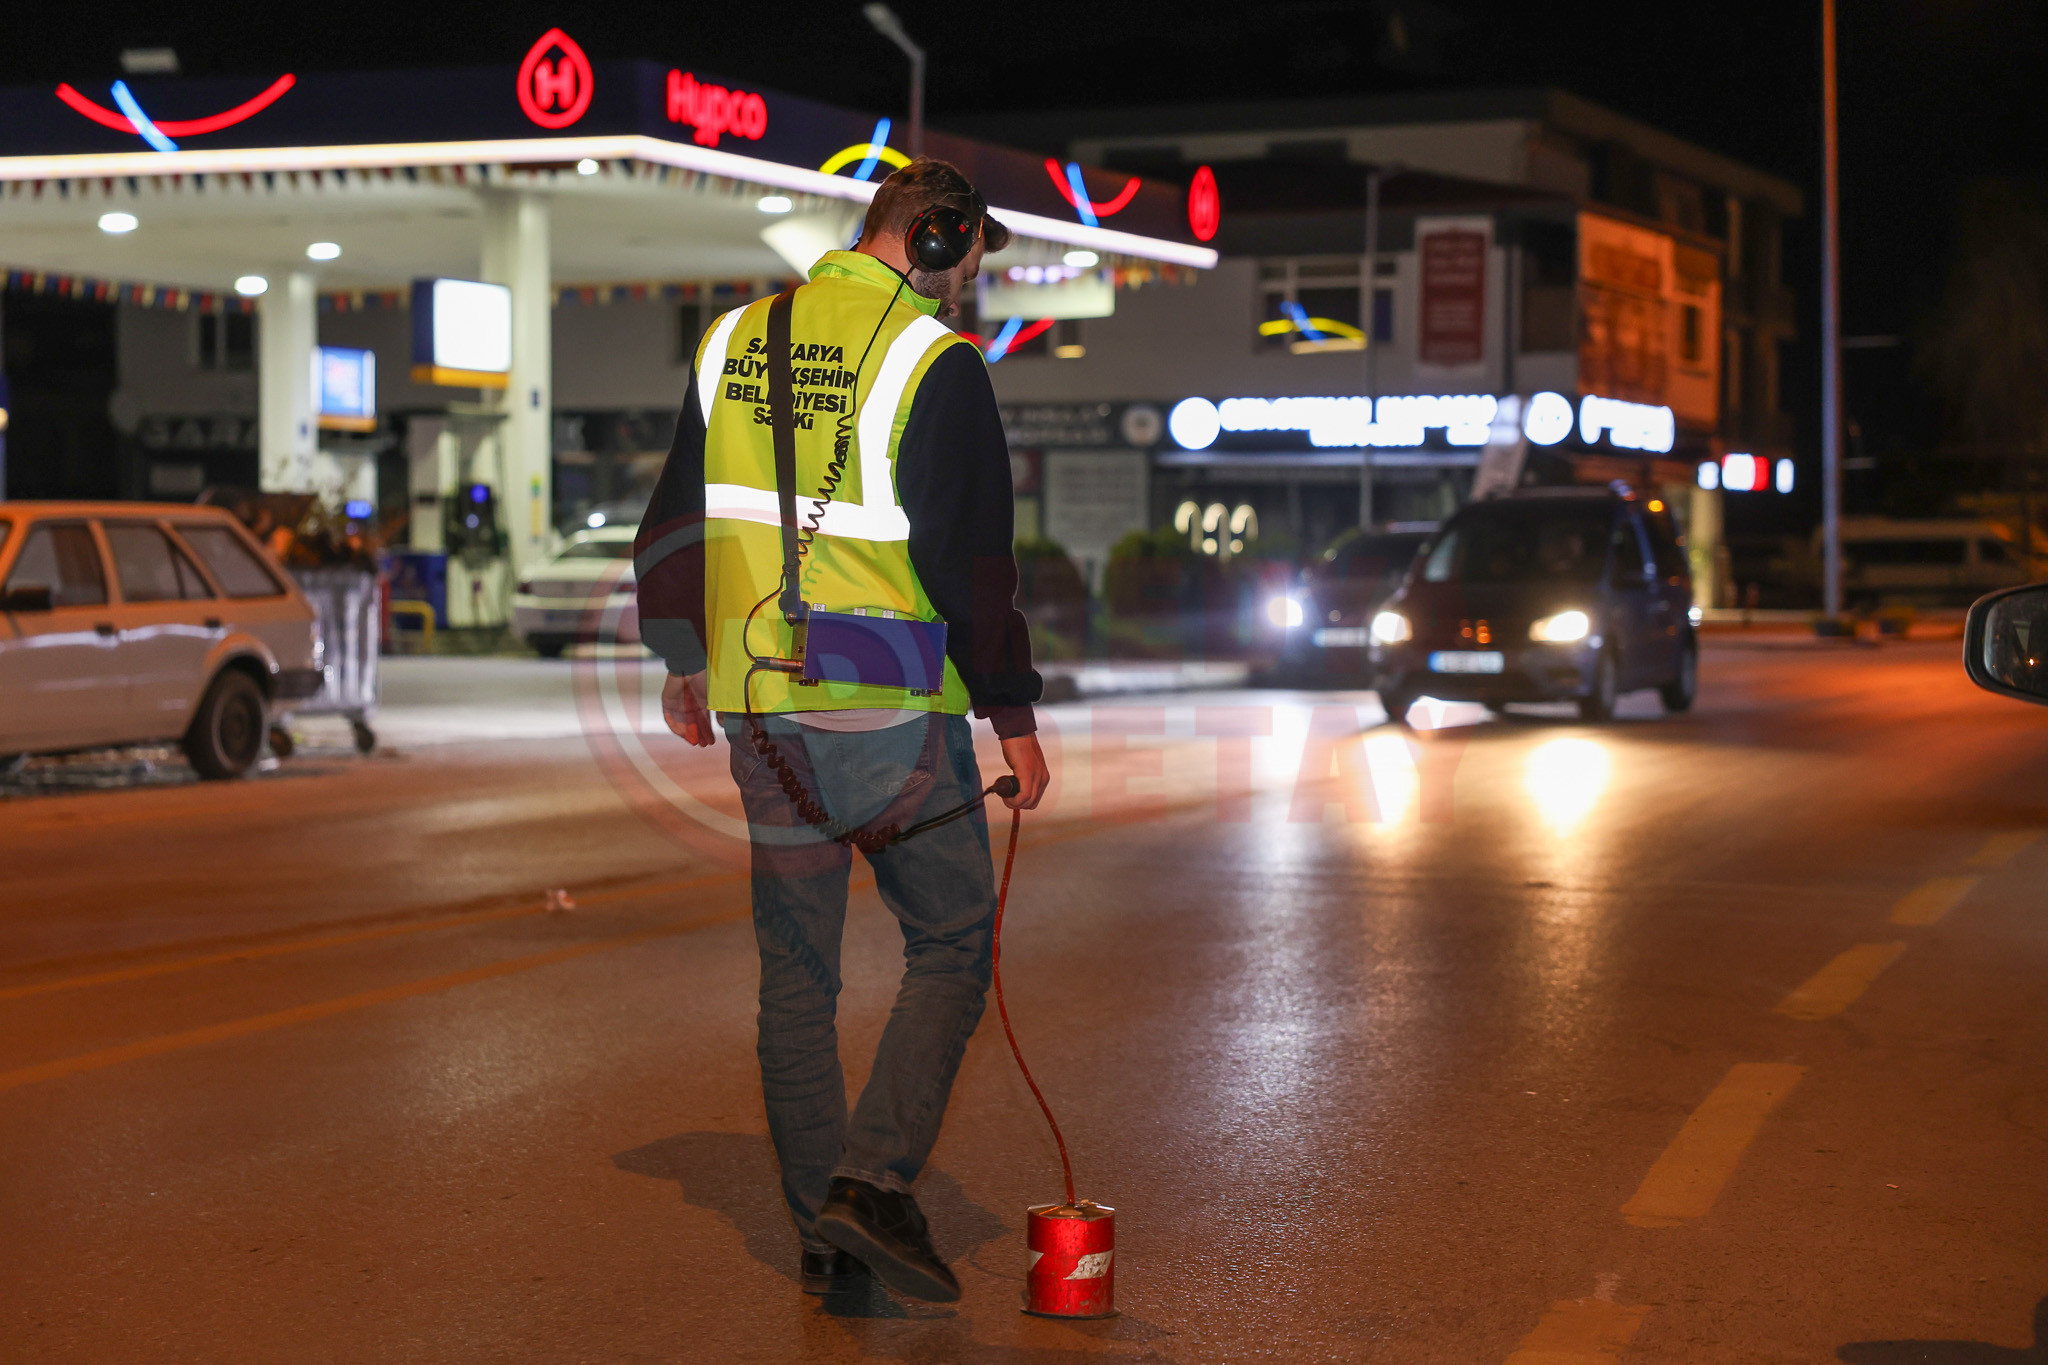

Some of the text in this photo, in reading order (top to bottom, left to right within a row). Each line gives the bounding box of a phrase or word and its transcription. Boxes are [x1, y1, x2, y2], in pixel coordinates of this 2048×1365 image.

[667, 69, 768, 148] Hypco
[746, 337, 843, 363] SARYA
[723, 355, 856, 390] BÜYKŞEHİR
[753, 407, 814, 430] SaKi
